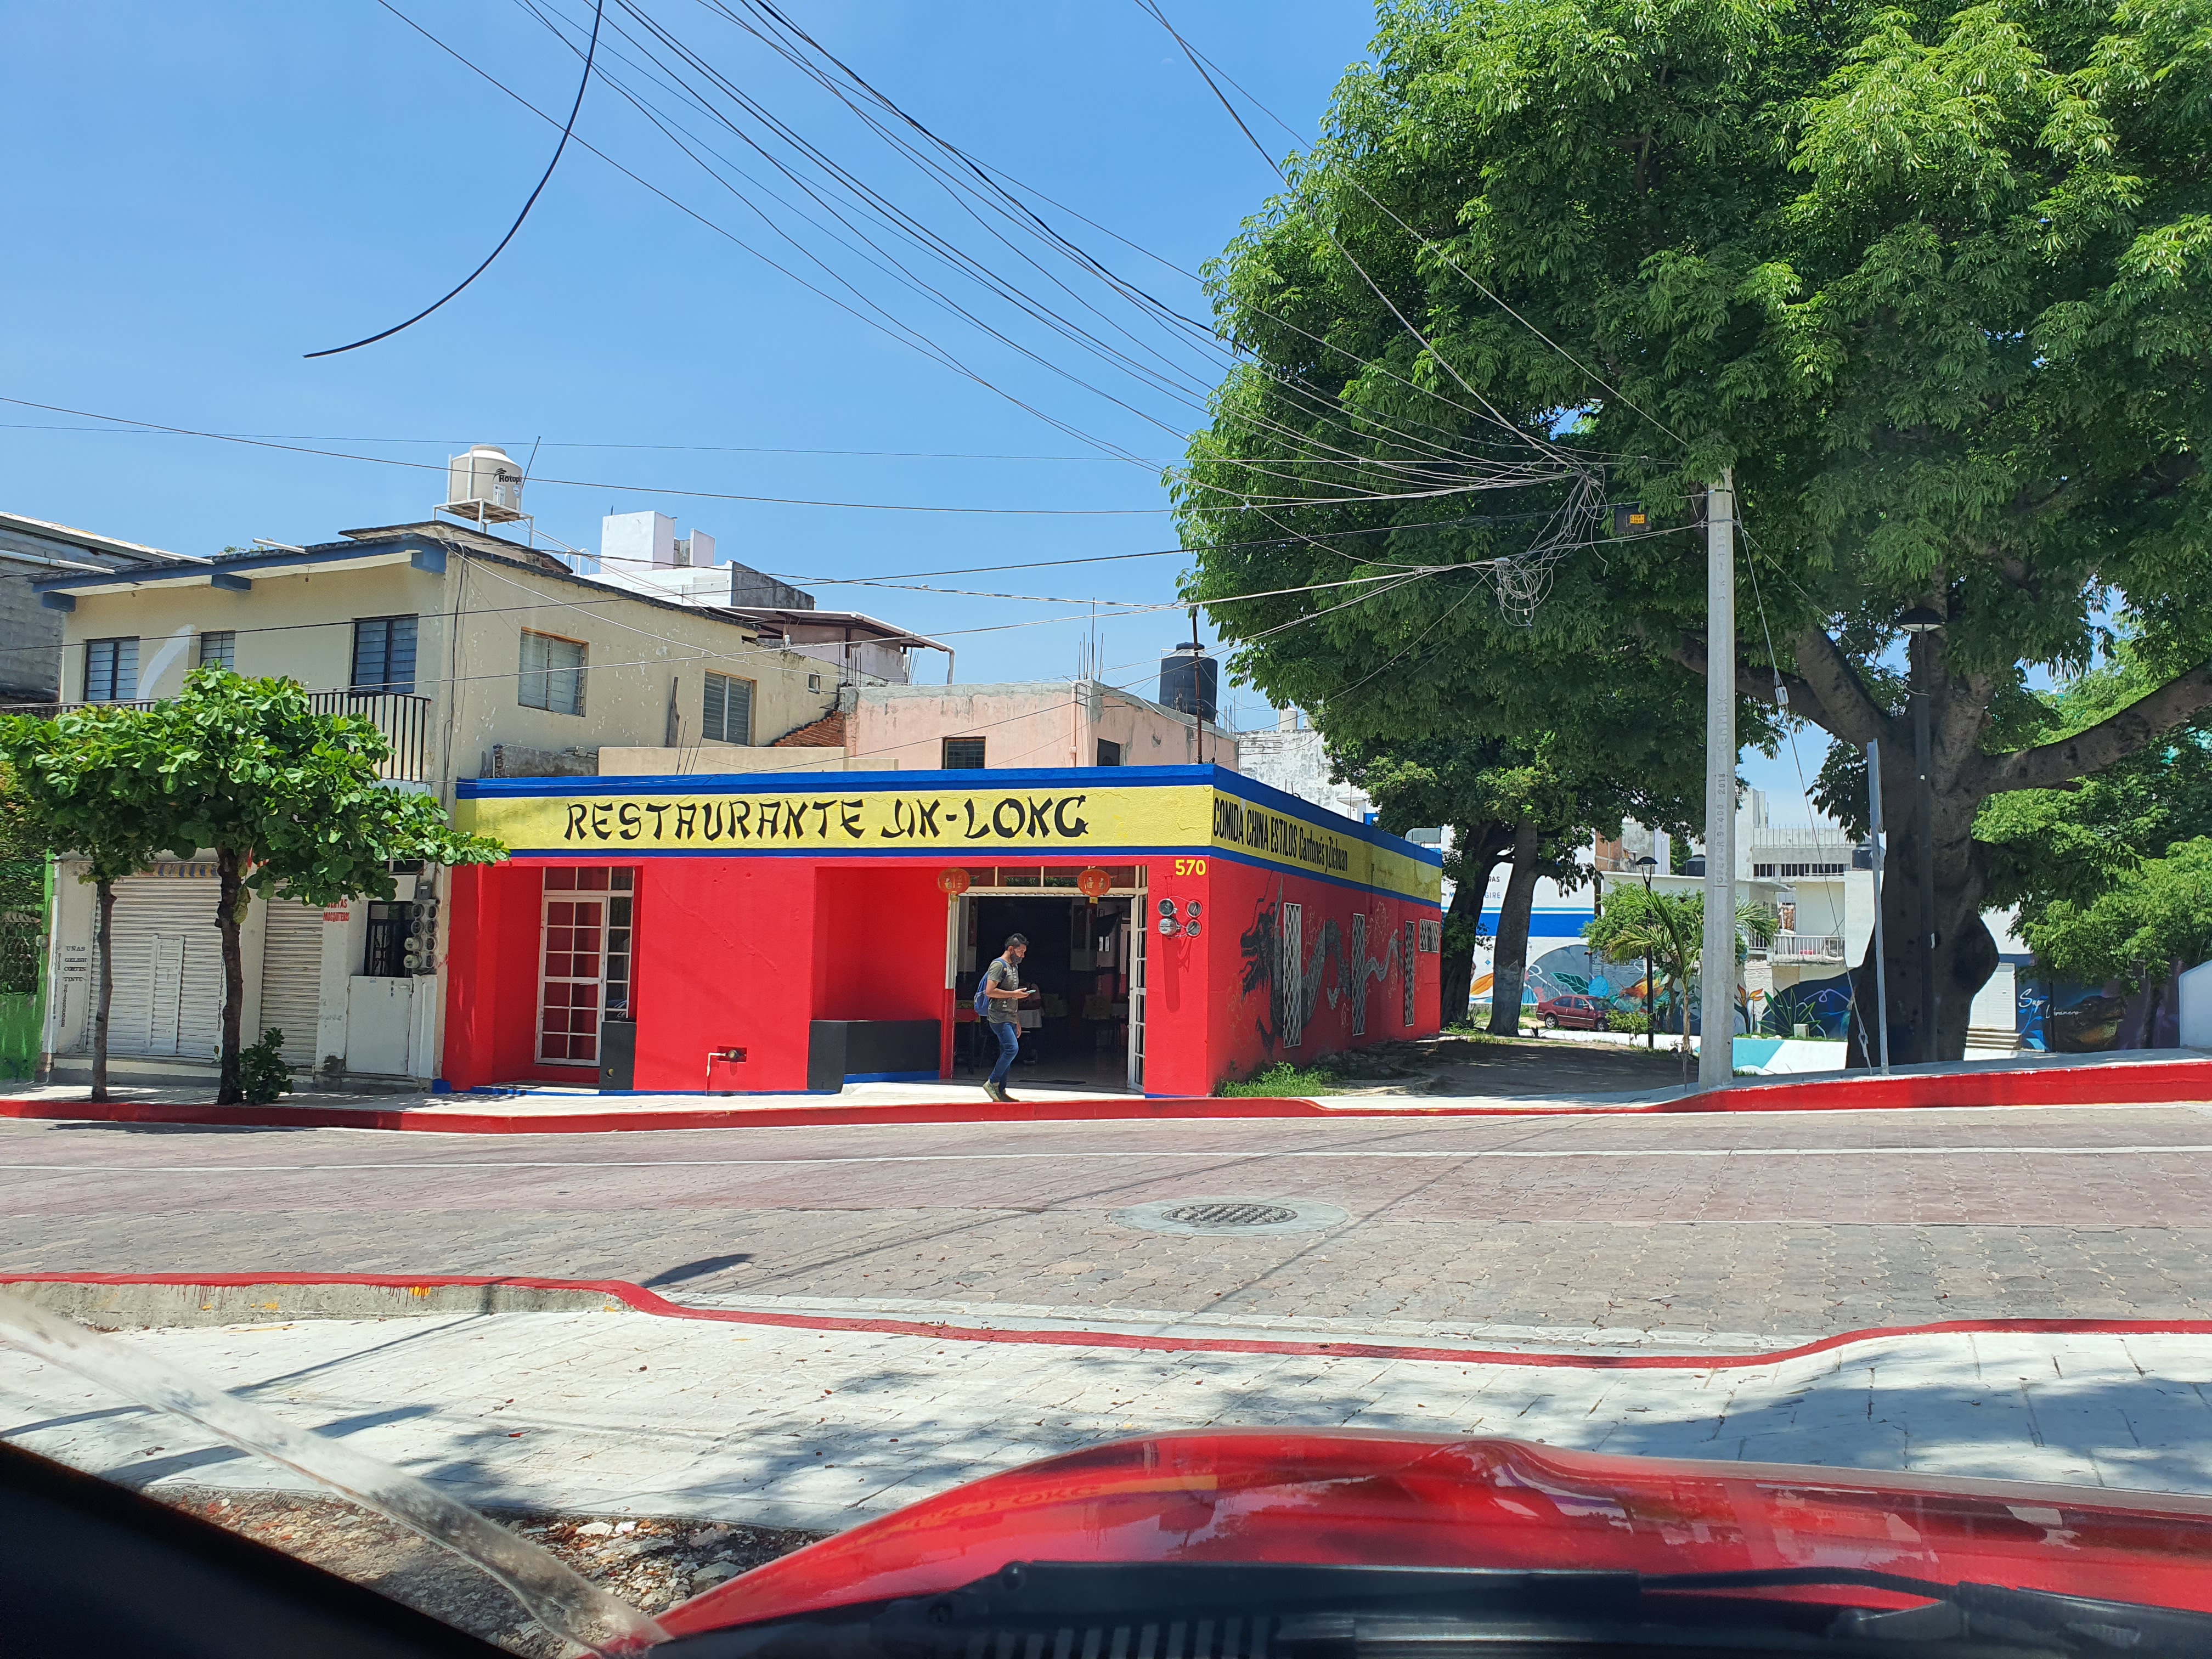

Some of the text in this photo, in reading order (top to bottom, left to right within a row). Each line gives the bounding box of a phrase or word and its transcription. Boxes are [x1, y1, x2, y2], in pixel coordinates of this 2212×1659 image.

[563, 799, 866, 841] RESTAURANTE
[1213, 797, 1348, 873] COMIDA CHINA ESTILOS Cantonés y Zichuan
[1175, 859, 1206, 876] 570
